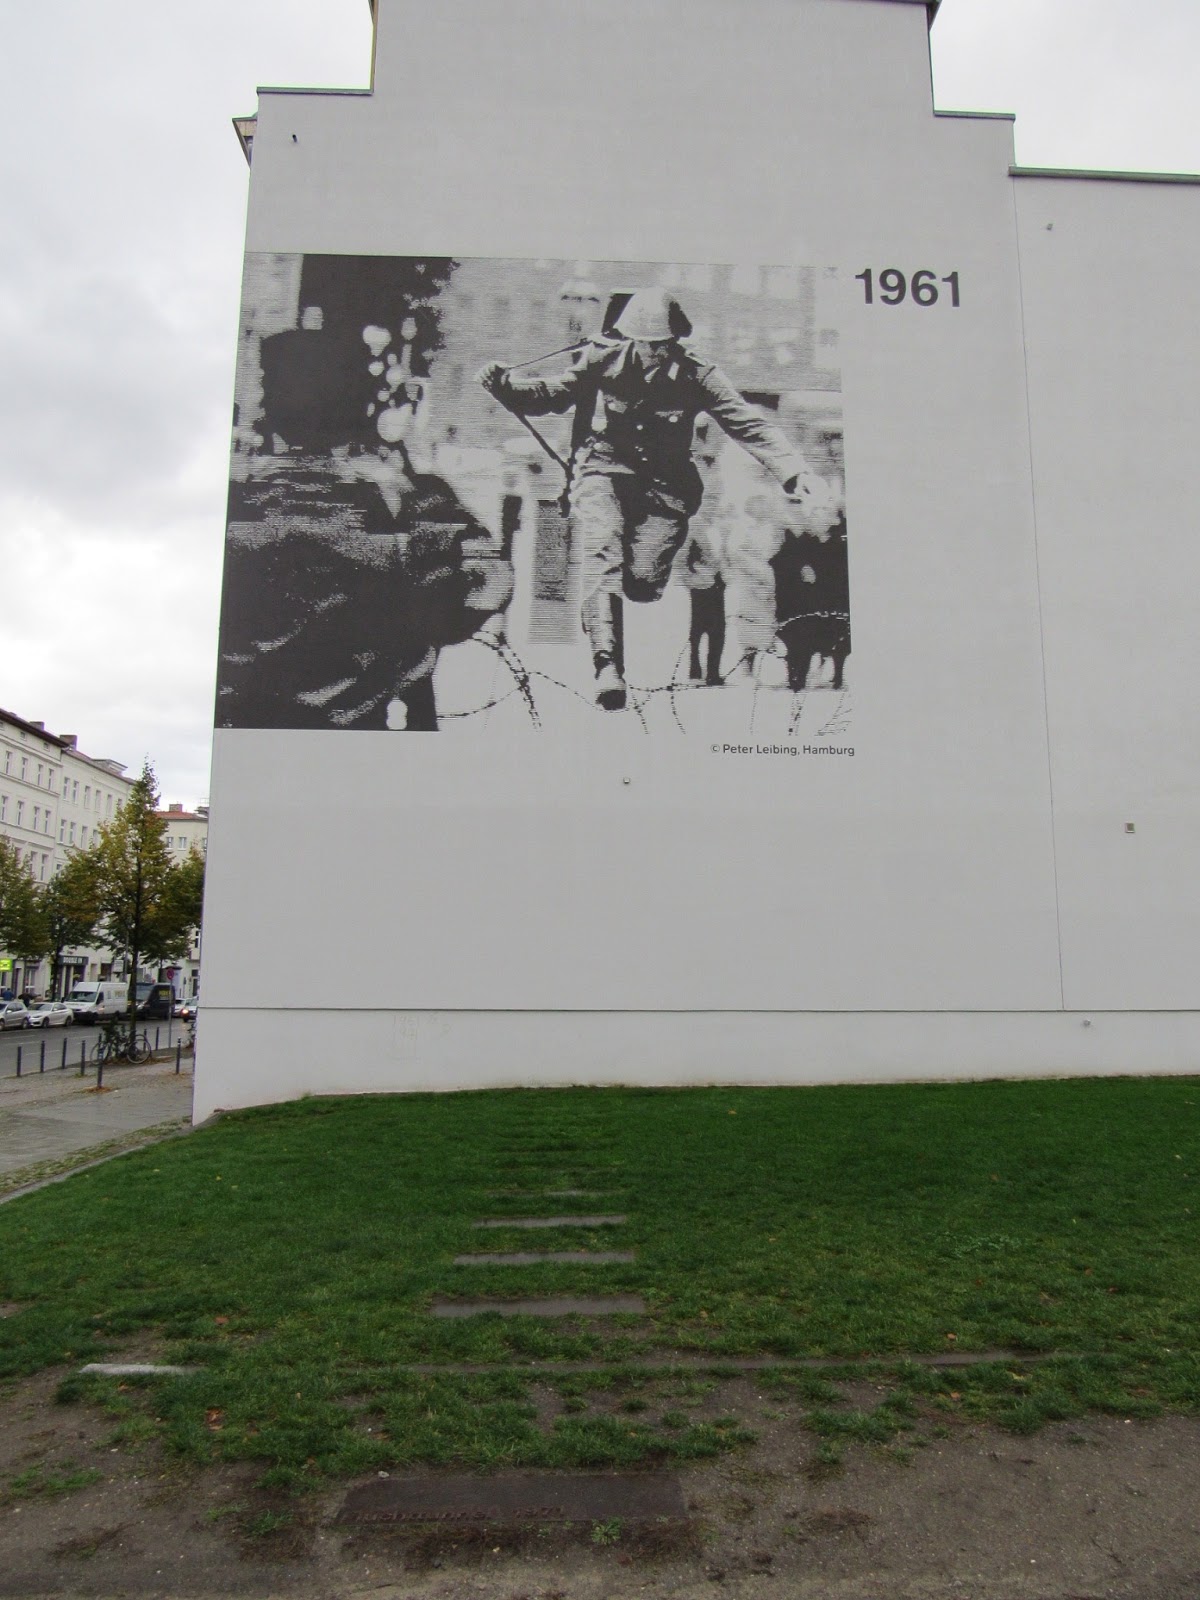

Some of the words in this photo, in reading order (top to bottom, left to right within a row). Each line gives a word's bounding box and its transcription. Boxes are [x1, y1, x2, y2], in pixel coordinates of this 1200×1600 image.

[855, 268, 960, 307] 1961
[723, 744, 753, 754] Peter
[756, 744, 800, 756] Leibing,
[803, 745, 855, 757] Hamburg
